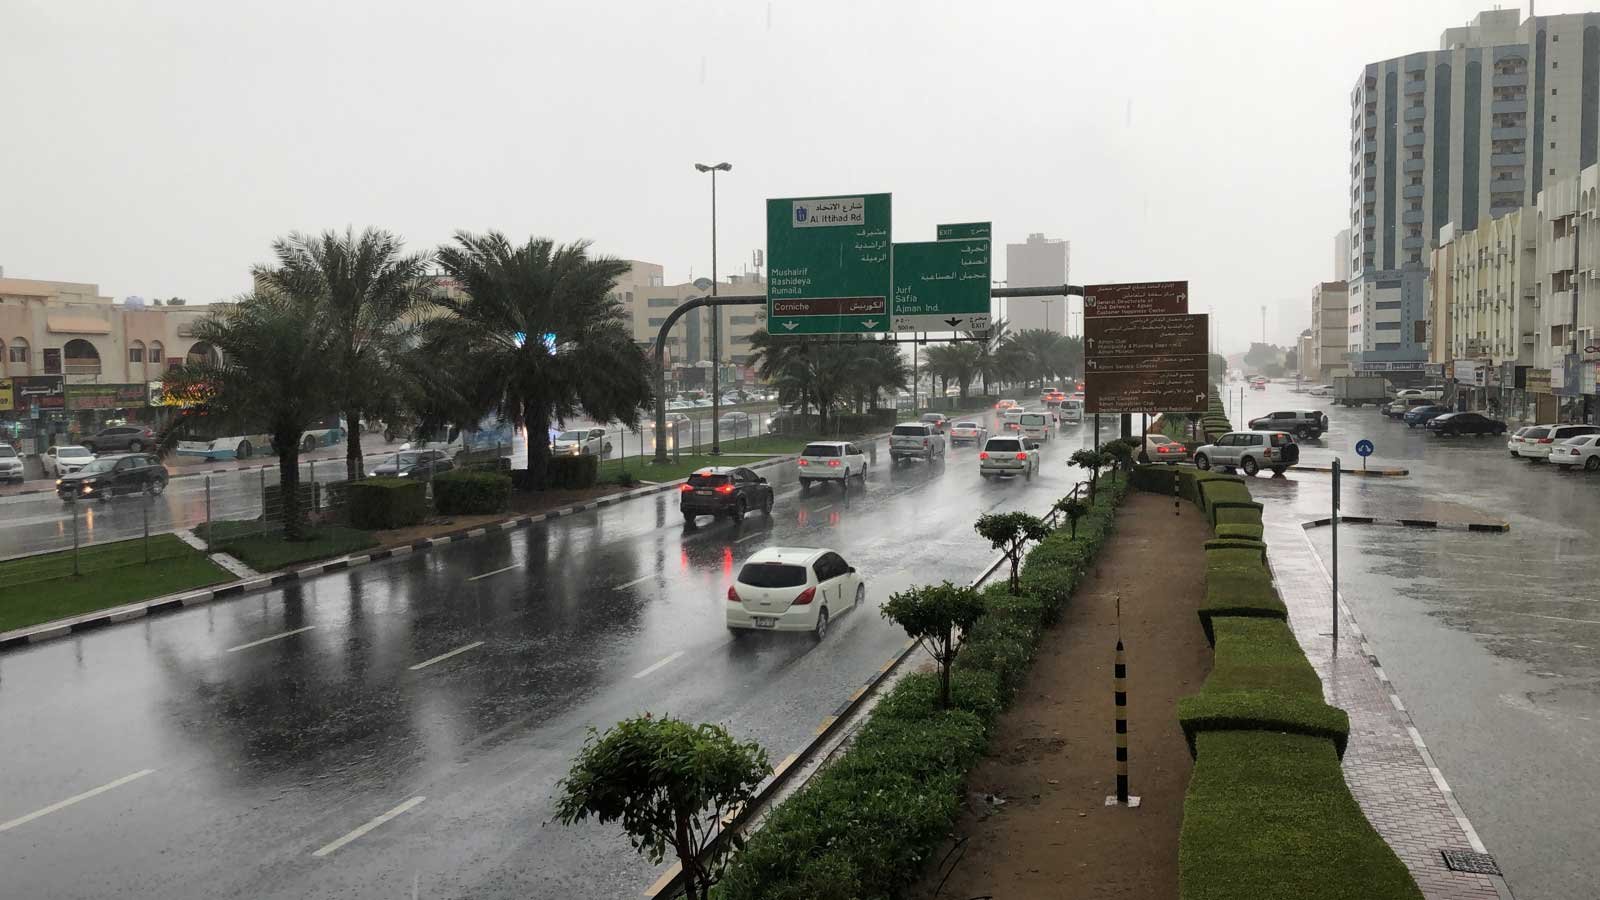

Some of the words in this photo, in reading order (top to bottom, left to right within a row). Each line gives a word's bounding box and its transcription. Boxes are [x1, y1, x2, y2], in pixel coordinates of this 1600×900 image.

[815, 203, 840, 211] الاتحاد
[842, 202, 863, 213] شارع
[810, 215, 819, 223] Al
[855, 240, 887, 250] الراشدية
[861, 253, 887, 262] الرميلة
[771, 268, 808, 277] Mushairif
[920, 271, 958, 281] الصناعية
[771, 278, 811, 287] Rashideya
[771, 287, 803, 295] Rumaila
[895, 286, 912, 295] Jurf
[895, 295, 918, 303] Safia
[774, 303, 810, 311] Corniche
[849, 301, 884, 311] الكورنيش
[895, 304, 922, 314] Ajman
